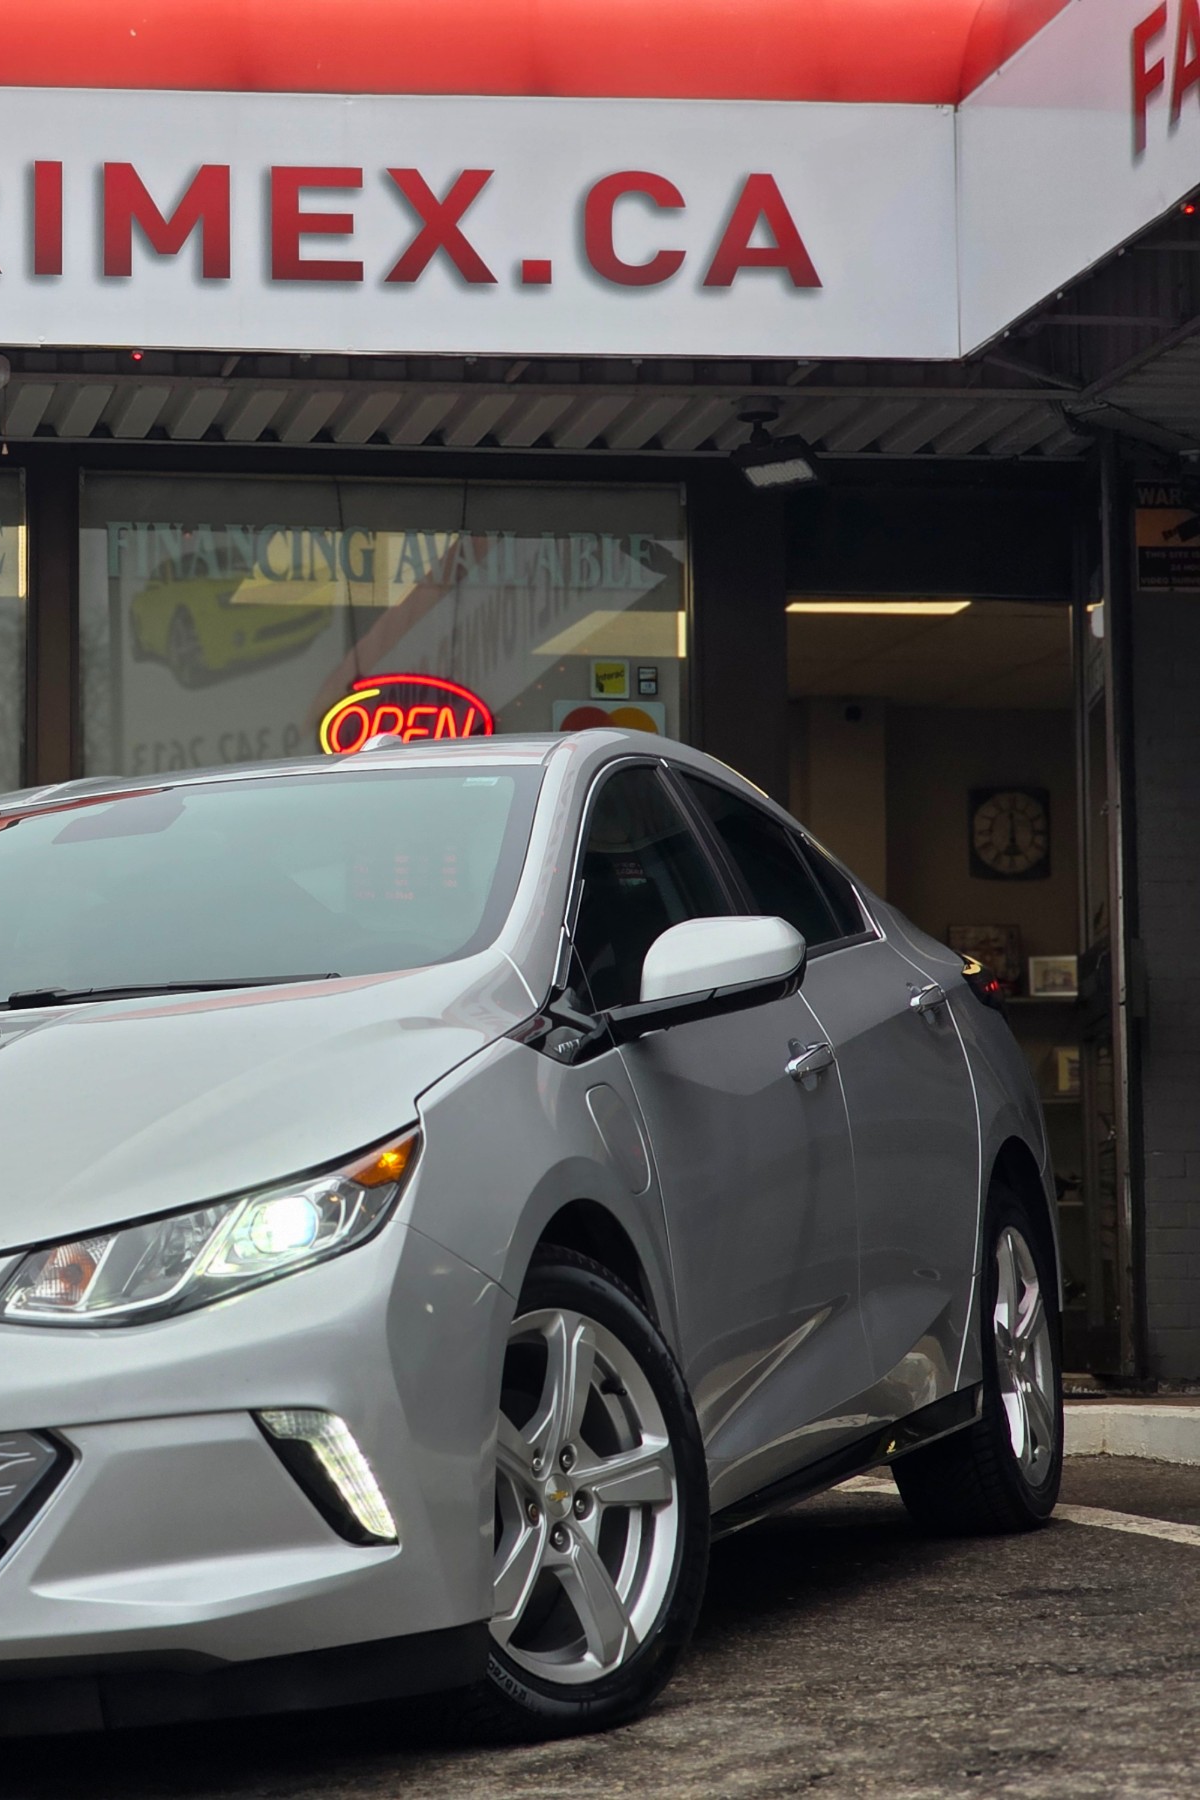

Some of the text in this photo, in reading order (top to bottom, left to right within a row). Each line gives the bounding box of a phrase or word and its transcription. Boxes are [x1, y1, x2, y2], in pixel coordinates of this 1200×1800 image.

[105, 521, 658, 589] FINANCING AVAILABLE
[329, 704, 478, 754] OPEN
